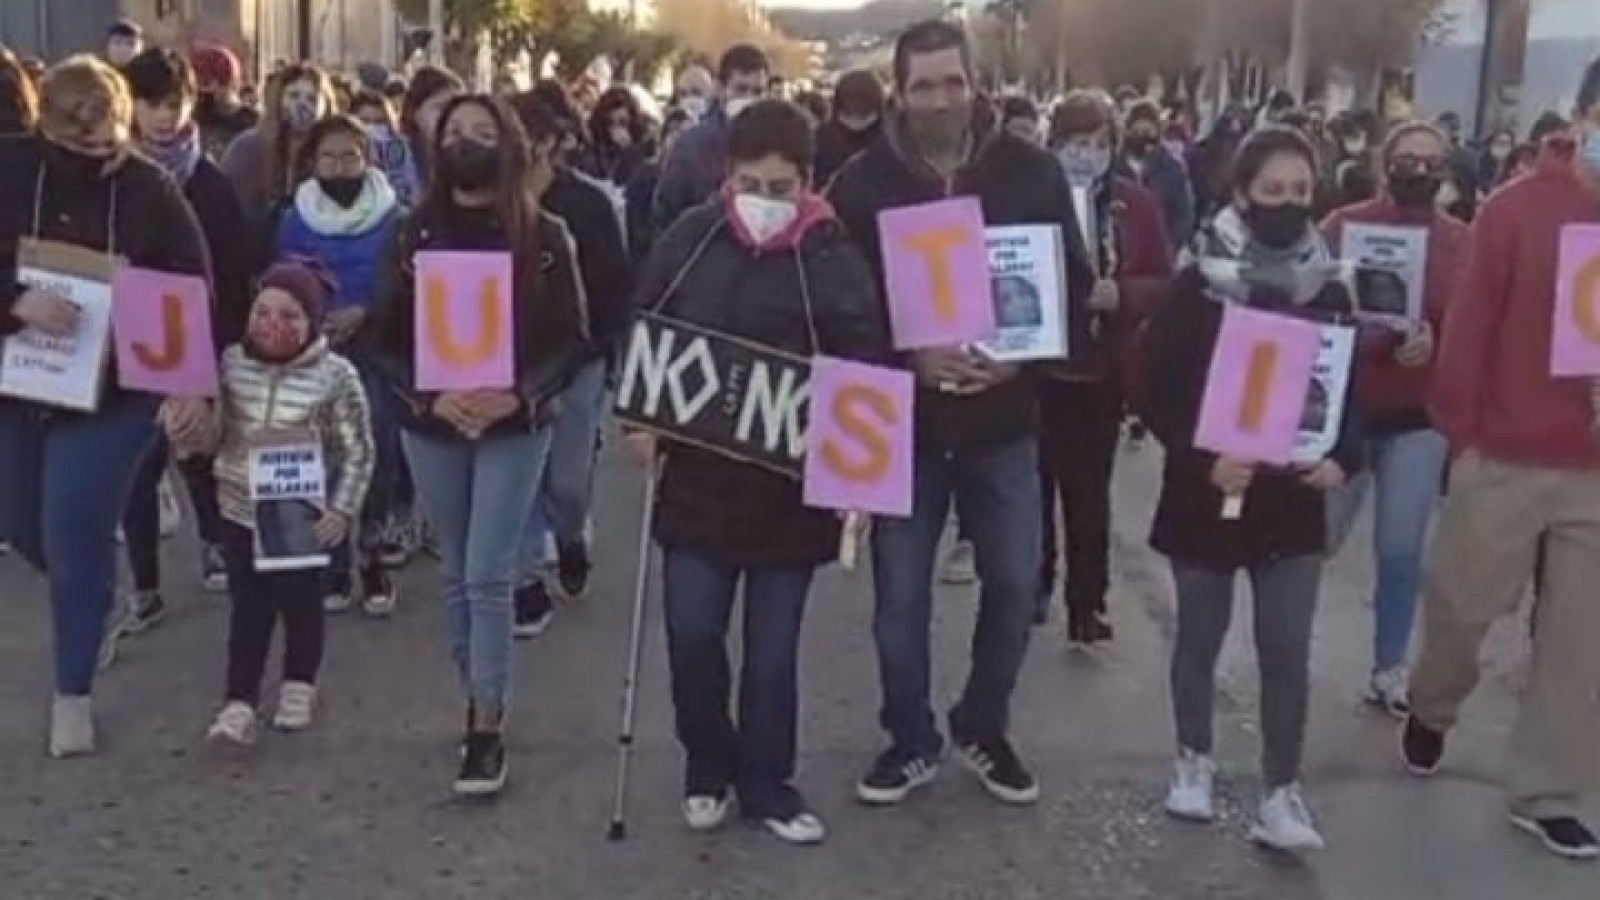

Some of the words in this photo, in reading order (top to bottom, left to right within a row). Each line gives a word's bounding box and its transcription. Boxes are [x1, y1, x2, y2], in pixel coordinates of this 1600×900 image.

[426, 273, 502, 369] U
[898, 226, 969, 326] T
[131, 295, 186, 371] J
[617, 319, 720, 424] NO
[821, 384, 899, 487] S
[1236, 340, 1279, 434] I
